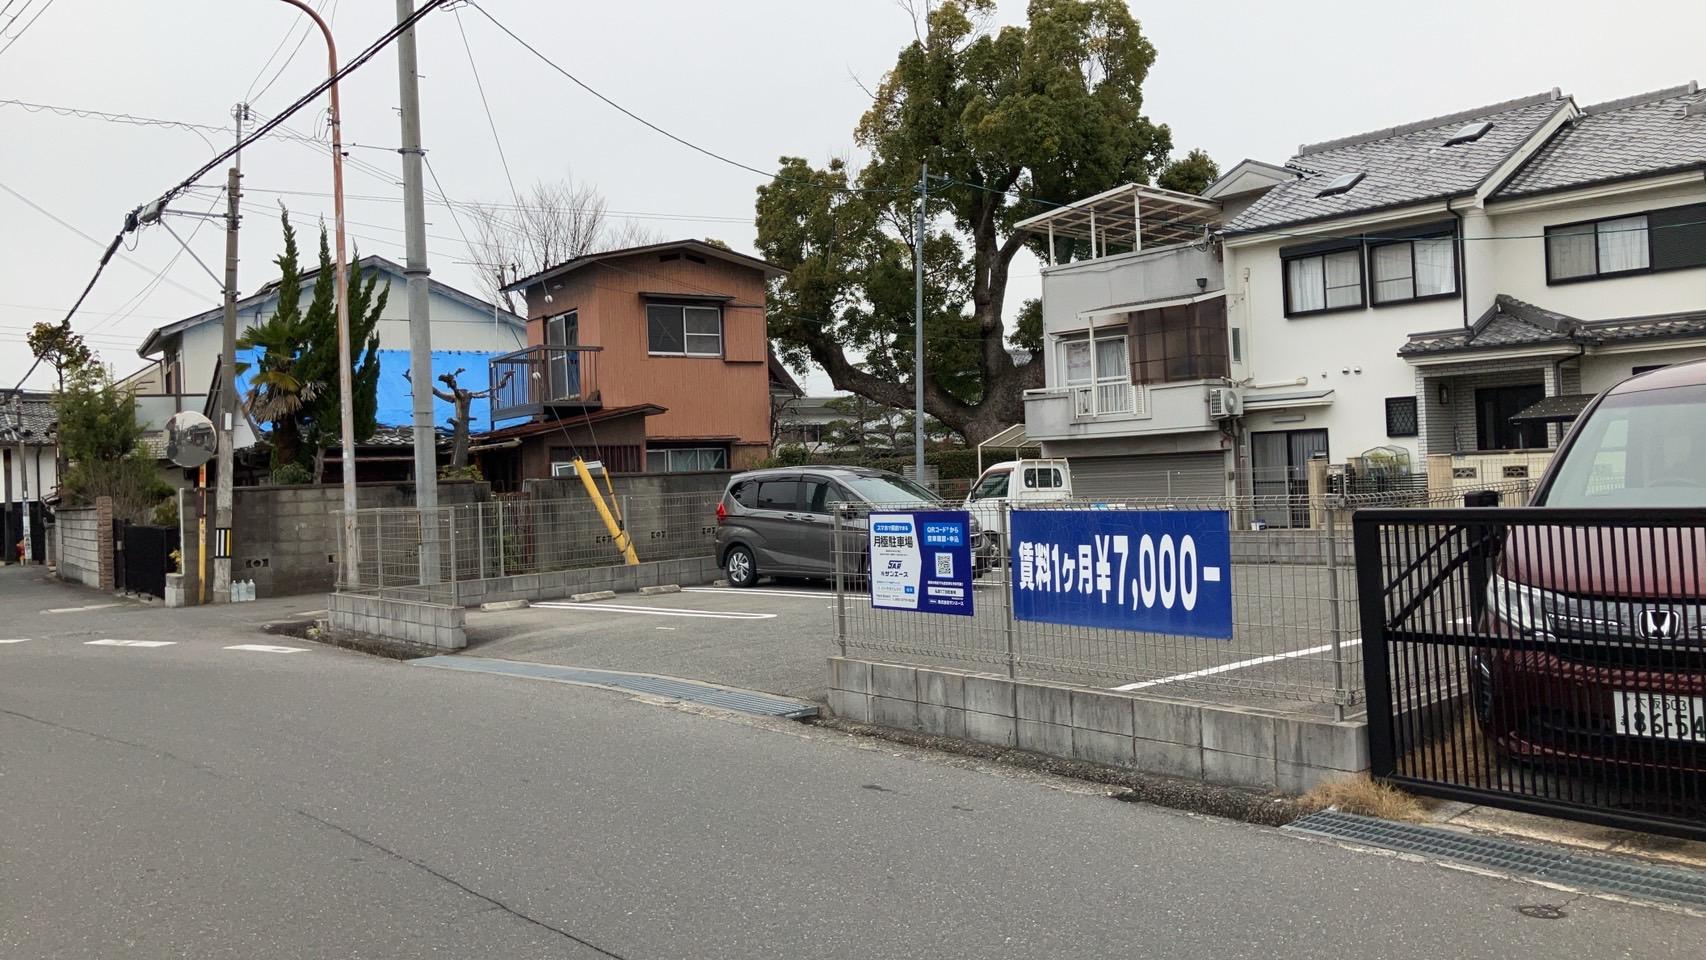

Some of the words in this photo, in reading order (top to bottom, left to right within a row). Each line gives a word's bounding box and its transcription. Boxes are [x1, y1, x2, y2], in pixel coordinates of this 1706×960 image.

[873, 536, 913, 548] 月極駐車場
